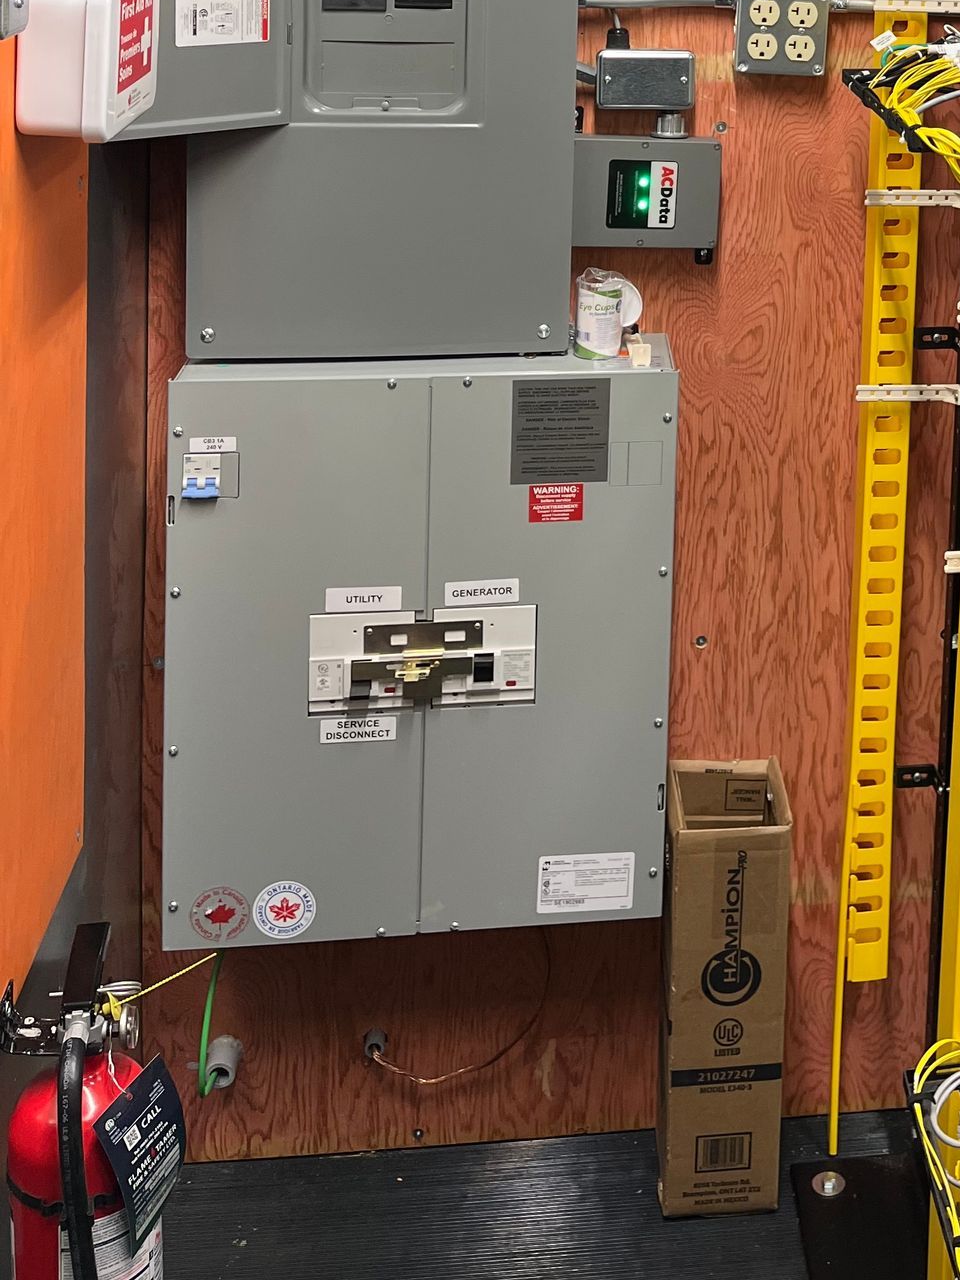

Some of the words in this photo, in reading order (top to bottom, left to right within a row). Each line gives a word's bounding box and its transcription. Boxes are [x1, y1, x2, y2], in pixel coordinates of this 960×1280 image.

[121, 0, 135, 22] First
[120, 42, 141, 64] Premiers
[119, 64, 133, 82] Soins
[659, 166, 675, 224] ACData
[579, 303, 592, 312] Eye
[594, 303, 615, 312] Cups
[533, 486, 580, 495] WARNING:
[346, 594, 383, 604] UTILITY
[452, 586, 513, 598] GENERATOR
[337, 719, 380, 729] SERVICE
[325, 729, 391, 741] DISCONNECT
[267, 884, 302, 897] ONTARIO
[302, 893, 313, 913] MADE
[718, 1024, 740, 1041] ULC
[714, 1047, 741, 1057] LISTED
[698, 1069, 756, 1082] 21027247
[699, 1086, 726, 1094] MODEL
[141, 1104, 162, 1129] CALL
[128, 1155, 152, 1186] FLAME
[155, 1123, 177, 1152] TAMER
[133, 1176, 143, 1191] FIRE
[147, 1147, 166, 1171] SAFETY
